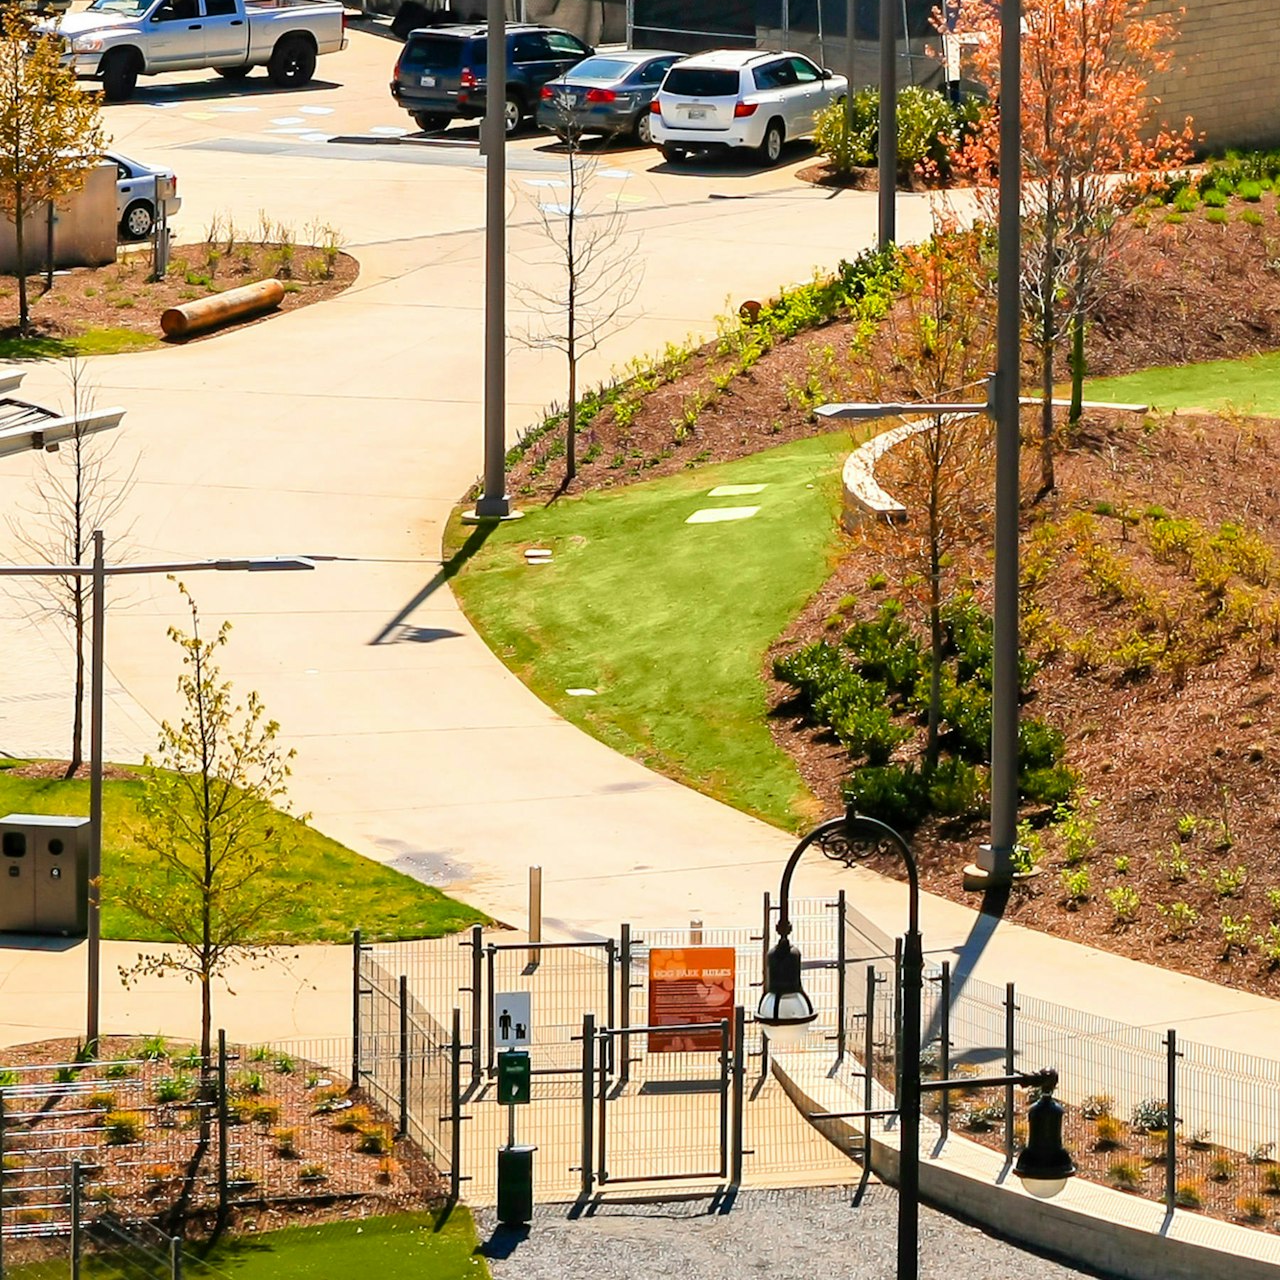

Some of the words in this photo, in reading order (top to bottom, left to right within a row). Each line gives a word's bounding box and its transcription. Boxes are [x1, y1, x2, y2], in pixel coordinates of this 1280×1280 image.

[653, 969, 675, 978] DOG
[676, 968, 699, 977] PARK
[702, 968, 732, 977] RULES
